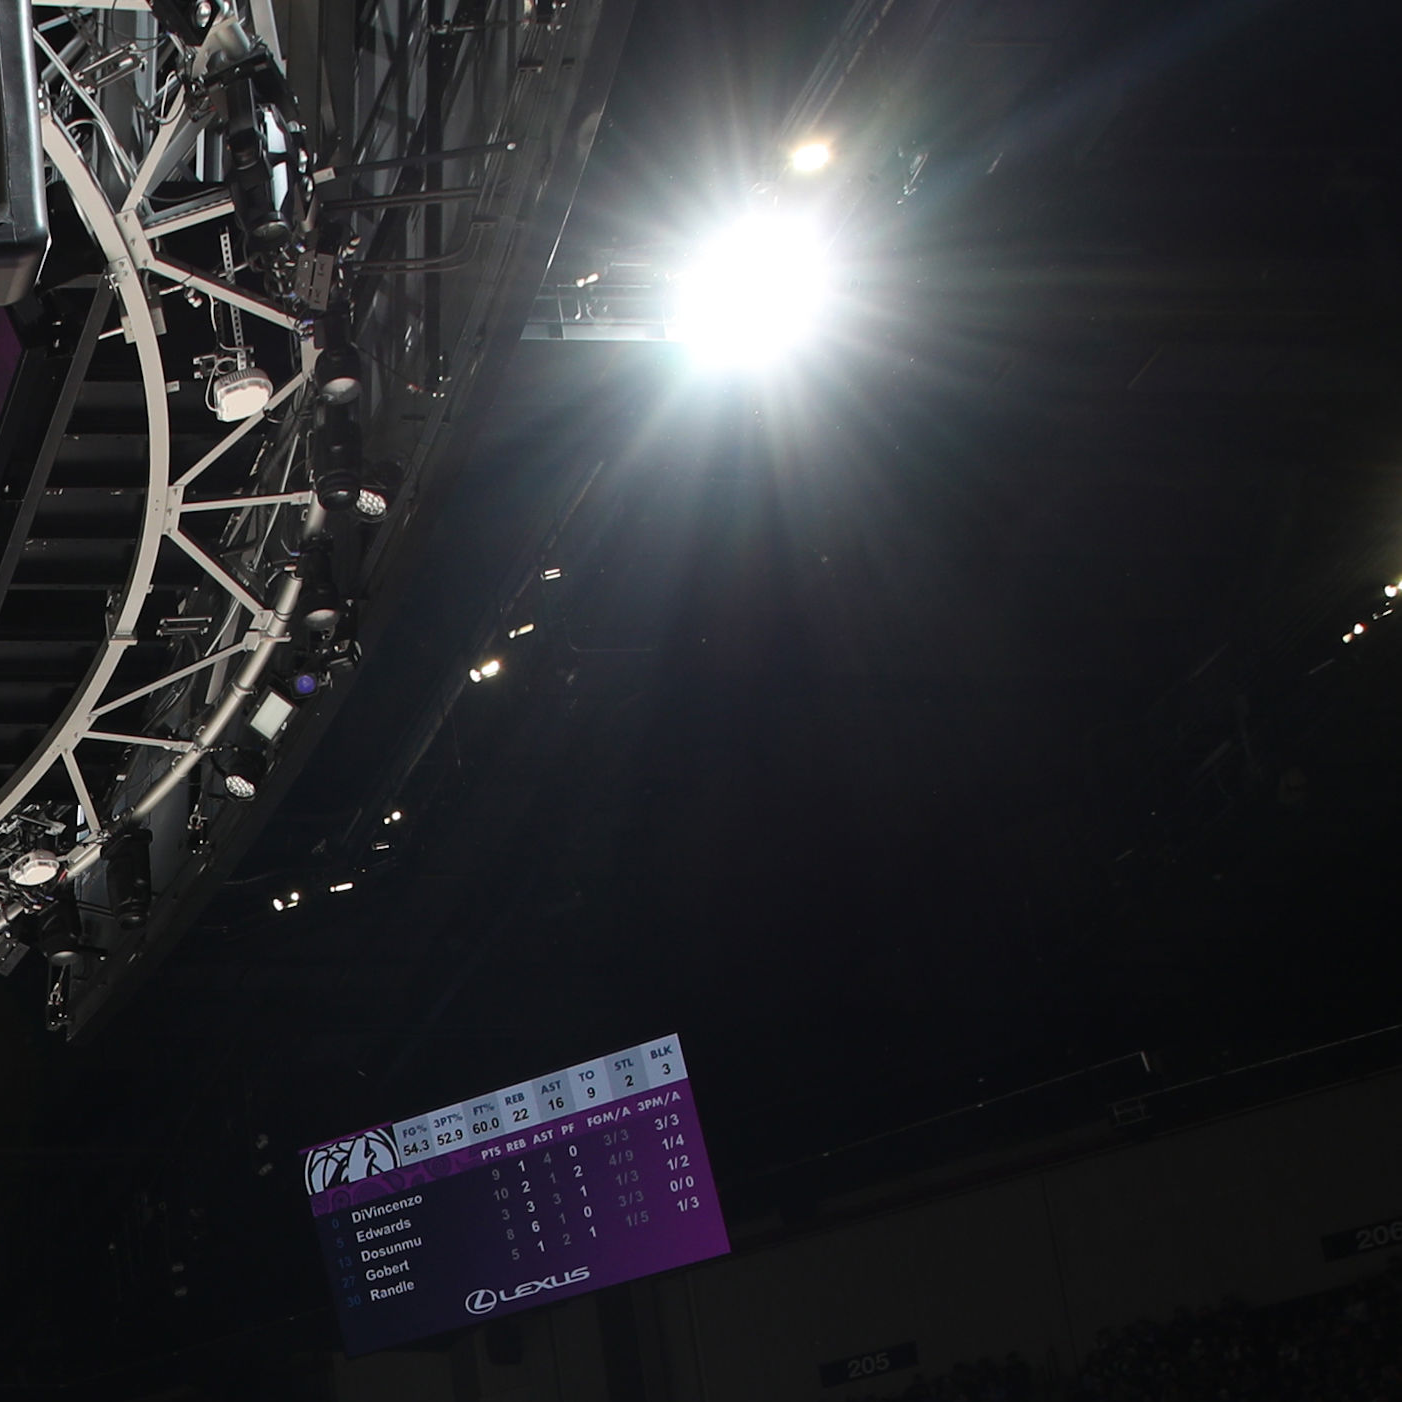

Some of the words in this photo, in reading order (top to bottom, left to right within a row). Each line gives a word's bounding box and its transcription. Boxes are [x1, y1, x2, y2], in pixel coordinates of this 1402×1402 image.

[504, 1093, 525, 1106] REB
[540, 1080, 562, 1095] AST
[578, 1070, 595, 1083] TO
[614, 1058, 634, 1072] STL
[650, 1045, 672, 1060] BLK
[403, 1139, 430, 1157] 54.3
[436, 1129, 464, 1146] 52.9
[472, 1118, 500, 1135] 60.0
[513, 1107, 529, 1123] 22
[548, 1097, 564, 1111] 16
[587, 1087, 596, 1099] 9
[625, 1075, 634, 1087] 2
[662, 1063, 671, 1075] 3
[481, 1146, 502, 1160] PTS
[506, 1138, 527, 1152] REB
[532, 1129, 554, 1145] AST
[561, 1123, 575, 1135] PF
[587, 1106, 631, 1128] FGM/A
[637, 1091, 681, 1112] 3PM/A
[351, 1194, 423, 1224] DiVincenzo
[356, 1217, 411, 1243] Edwards
[360, 1235, 422, 1262] Dosunmu
[365, 1260, 410, 1282] Gobert
[499, 1266, 590, 1302] LEXUS
[370, 1280, 415, 1302] Randle
[848, 1352, 889, 1379] 205
